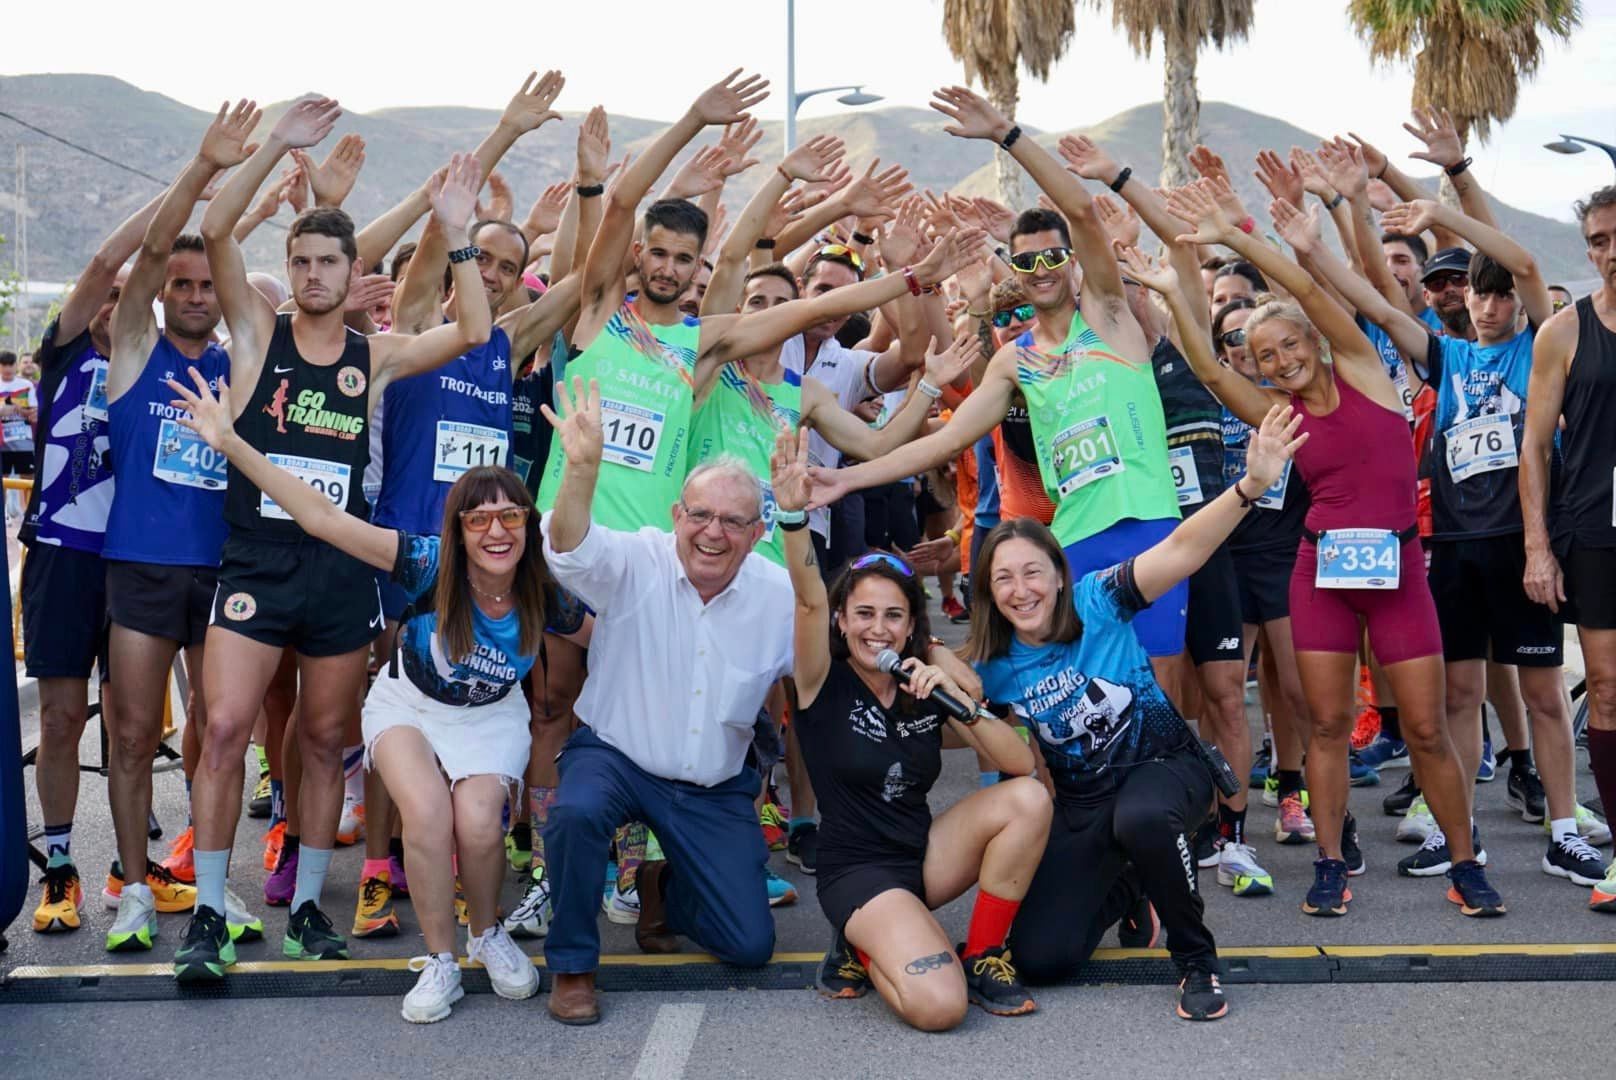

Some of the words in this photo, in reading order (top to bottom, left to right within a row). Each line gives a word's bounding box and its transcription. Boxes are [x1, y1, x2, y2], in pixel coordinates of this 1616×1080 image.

[297, 388, 326, 410] GO
[286, 403, 364, 434] TRAINING
[304, 425, 338, 438] RUNNING
[338, 431, 357, 441] CLUB
[608, 418, 655, 451] 110
[1469, 430, 1503, 456] 76
[181, 443, 228, 474] 402
[462, 441, 500, 466] 111
[1065, 431, 1112, 471] 201
[1341, 545, 1397, 572] 334
[458, 654, 517, 681] UNNING
